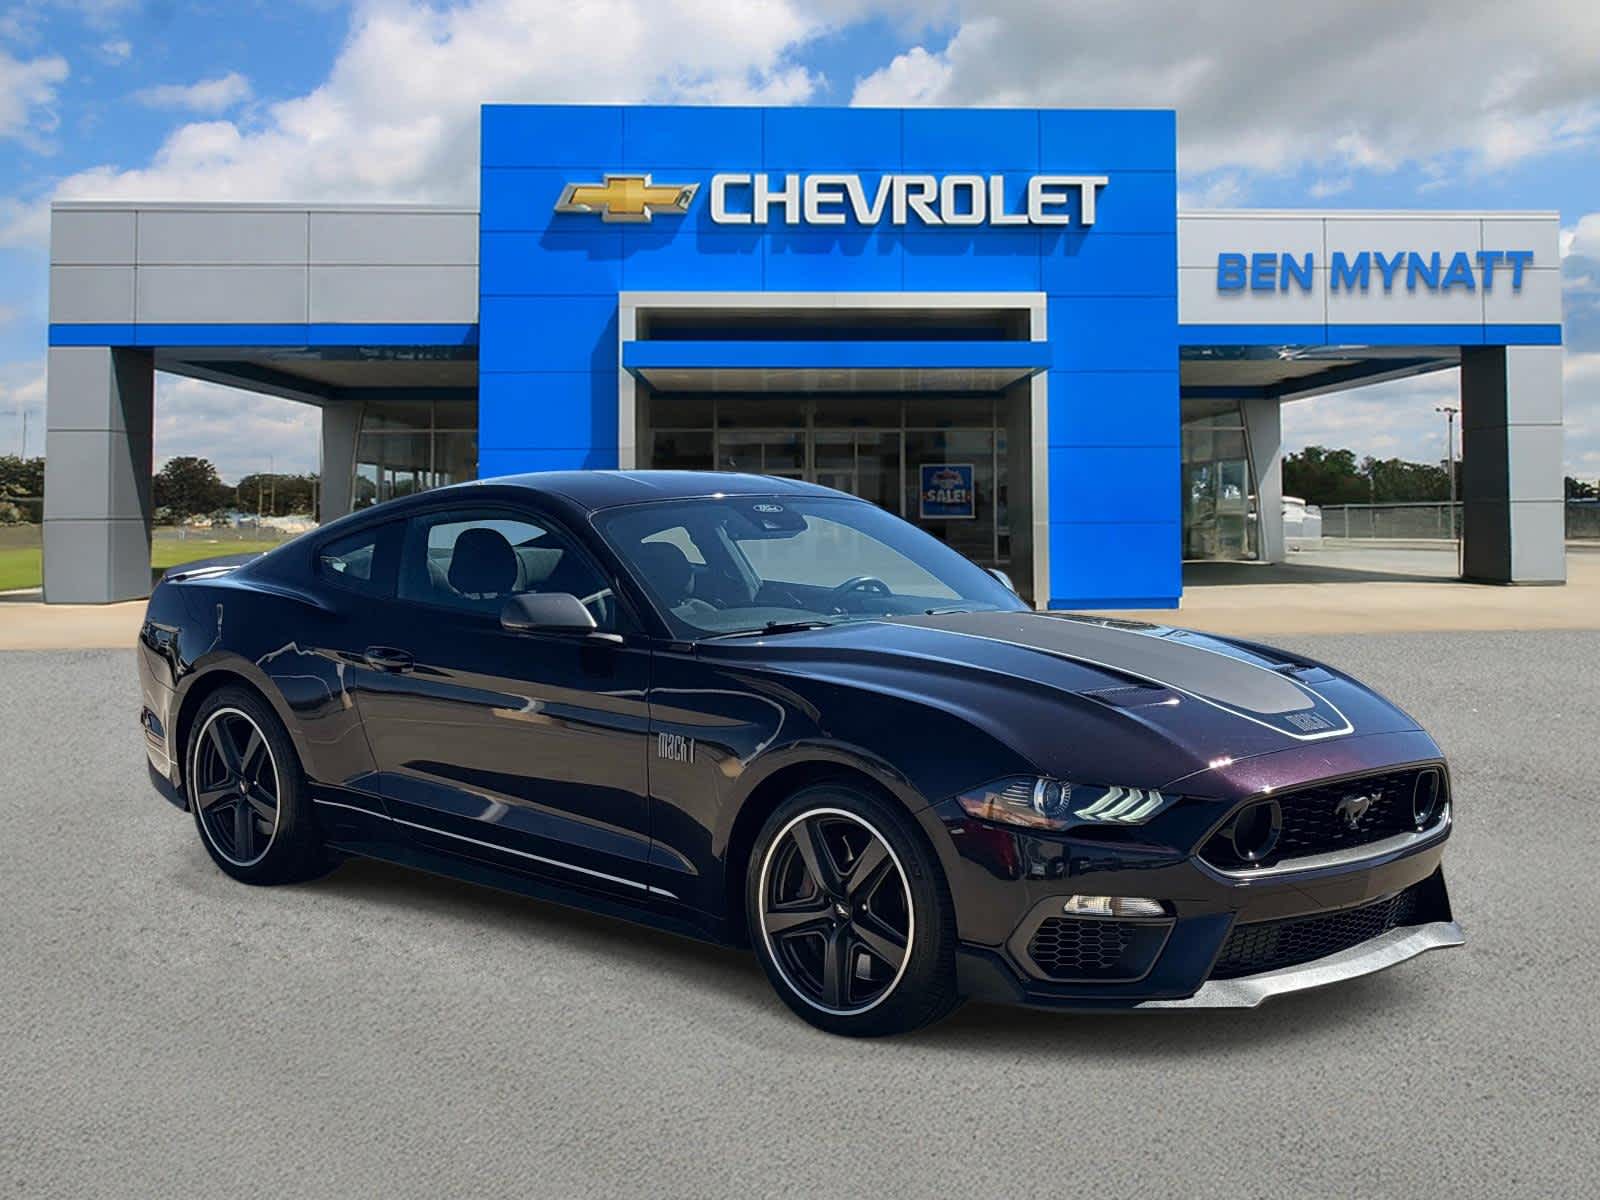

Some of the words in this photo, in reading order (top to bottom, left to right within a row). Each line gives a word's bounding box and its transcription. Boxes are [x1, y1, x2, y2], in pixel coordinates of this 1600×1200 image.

[711, 174, 1109, 225] CHEVROLET
[1217, 252, 1313, 290] BEN
[1330, 250, 1534, 290] MYNATT
